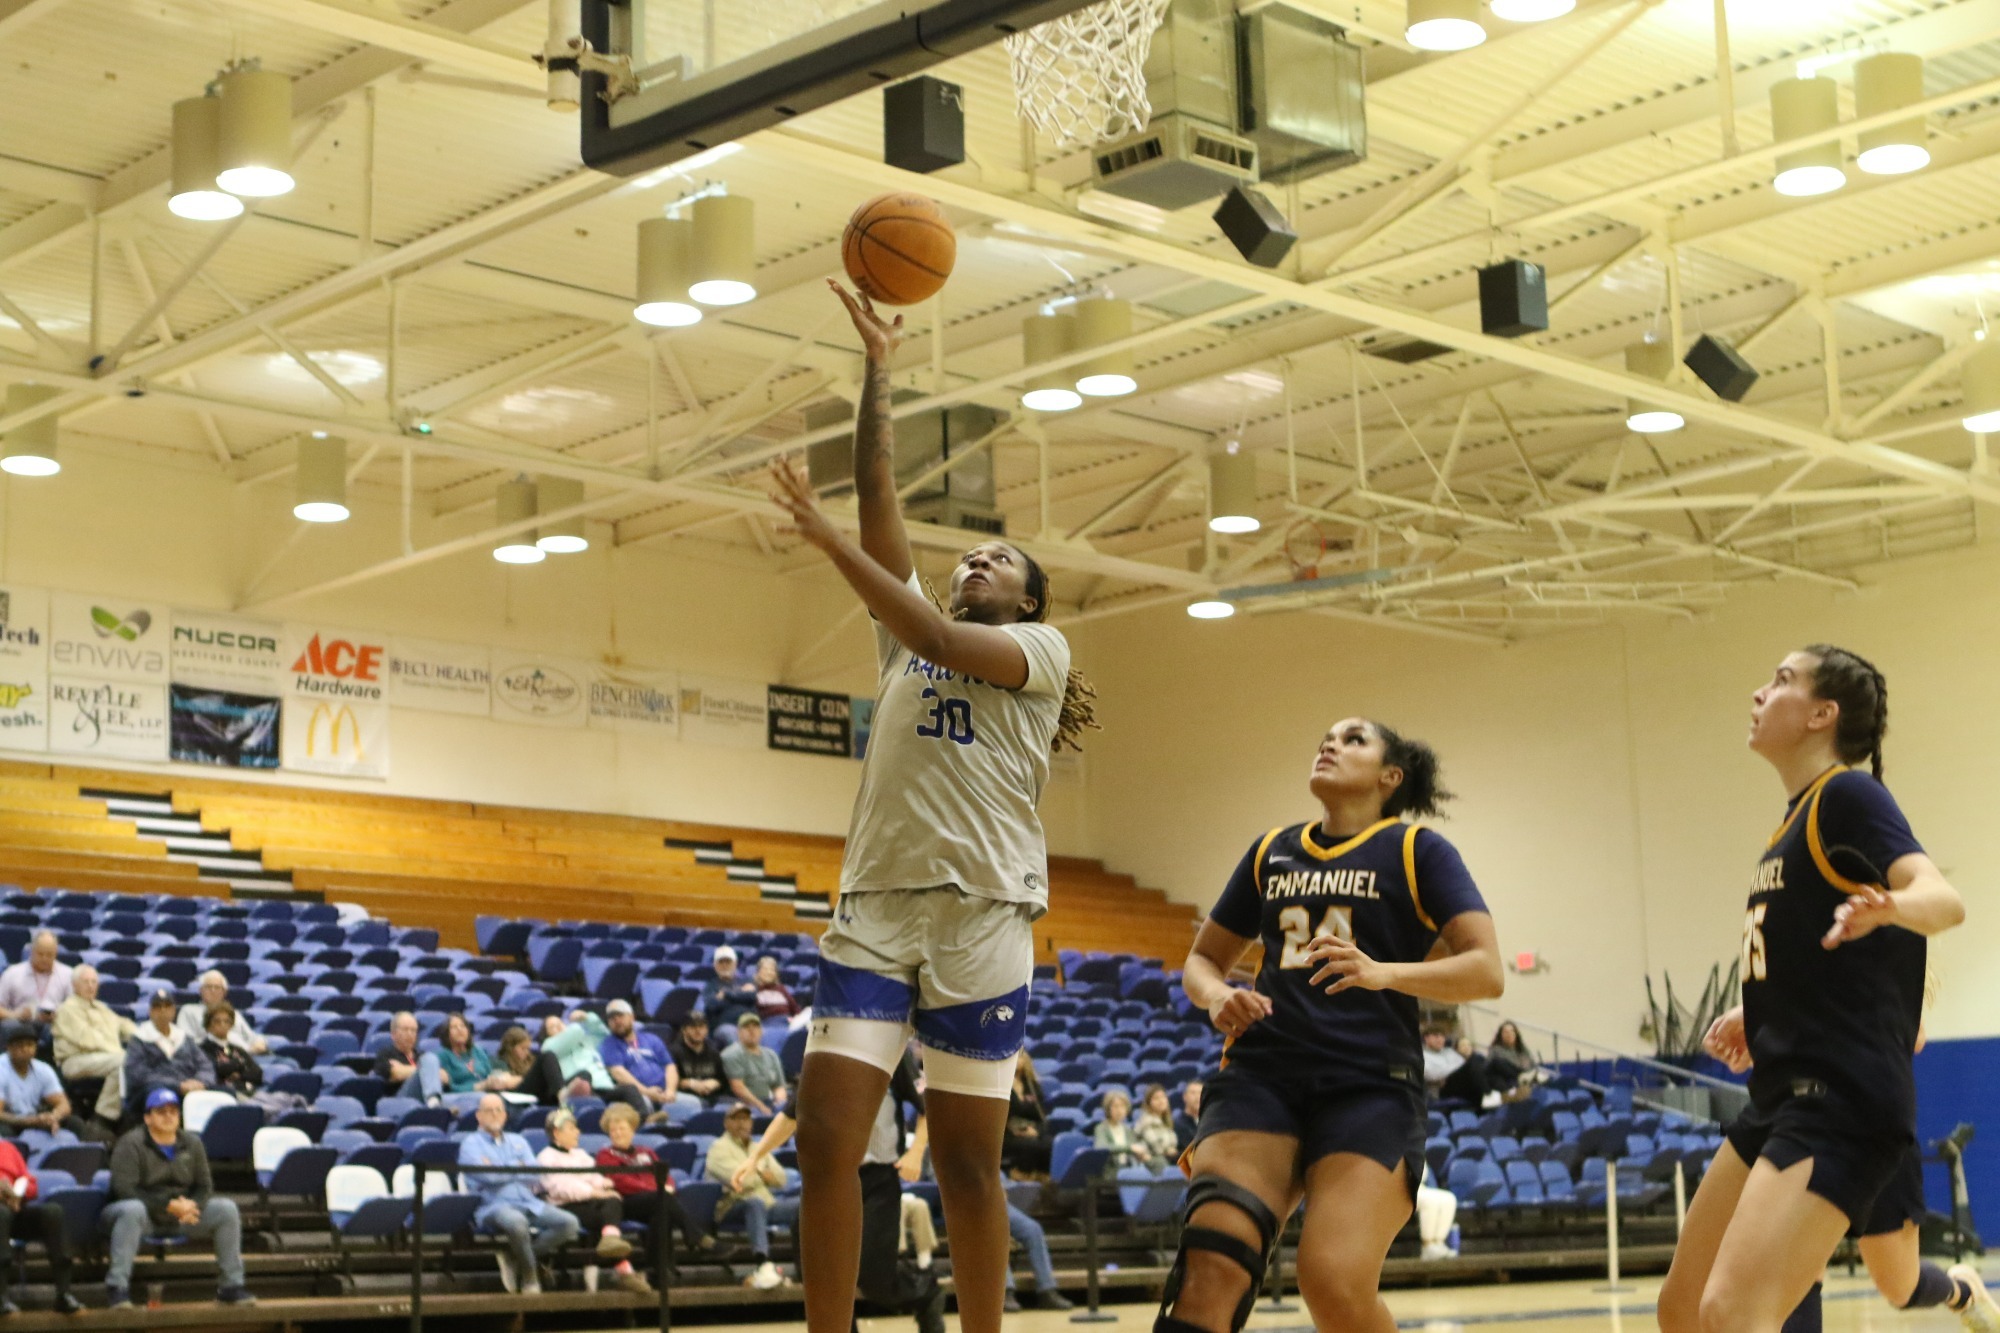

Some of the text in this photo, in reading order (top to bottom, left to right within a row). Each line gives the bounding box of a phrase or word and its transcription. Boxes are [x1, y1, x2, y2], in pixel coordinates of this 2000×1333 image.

[173, 625, 277, 653] NUCOR
[54, 641, 163, 672] enviva
[290, 631, 384, 682] ACE
[296, 675, 381, 699] Hardware
[436, 666, 491, 684] HEALTH
[768, 692, 814, 714] INSERT
[819, 699, 850, 719] COIN
[917, 687, 975, 745] 30
[1266, 869, 1380, 900] EMMANUEL
[1279, 905, 1353, 969] 24
